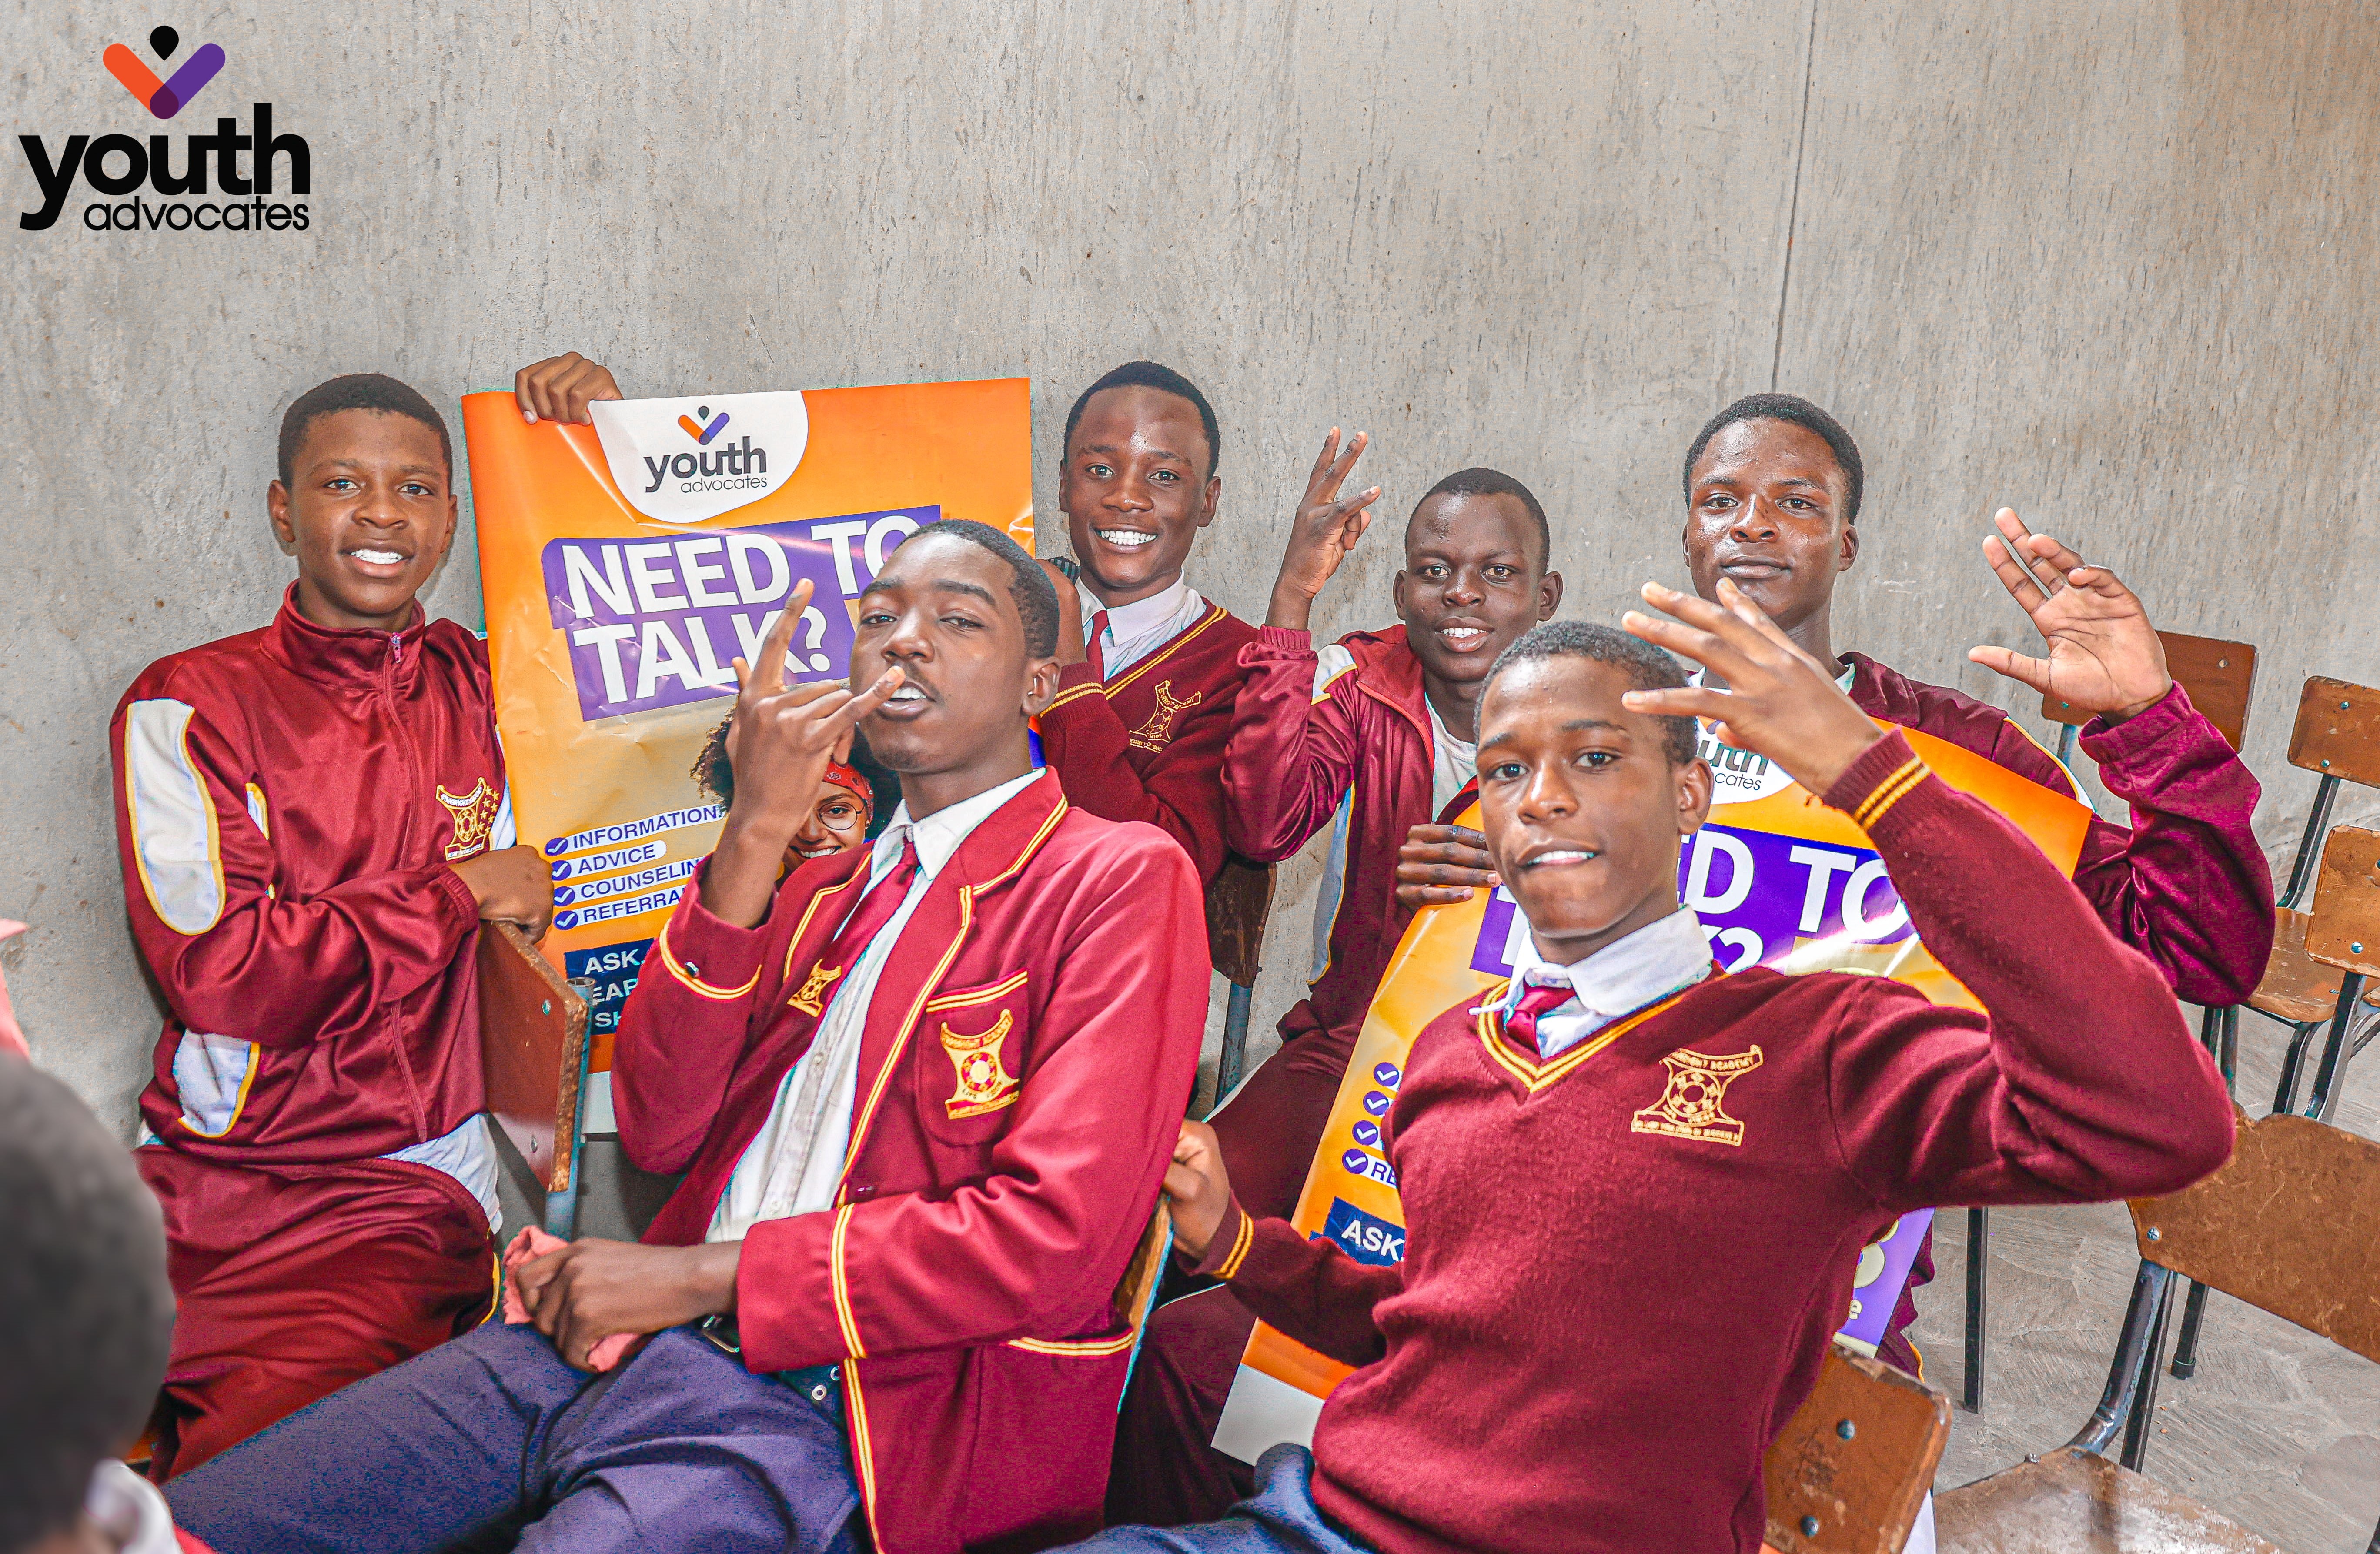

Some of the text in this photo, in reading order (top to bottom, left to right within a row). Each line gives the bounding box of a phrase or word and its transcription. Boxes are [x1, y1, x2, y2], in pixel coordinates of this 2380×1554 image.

[643, 436, 767, 493] youth
[681, 475, 767, 493] advocates
[562, 515, 921, 619] NEED TO
[573, 605, 832, 705] TALK?
[1697, 740, 1770, 776] uth
[1715, 772, 1762, 791] cates
[573, 806, 717, 849] INFORMATION
[578, 845, 656, 874] ADVICE
[581, 859, 699, 898] COUNSELIN
[584, 889, 685, 923] REFERRA
